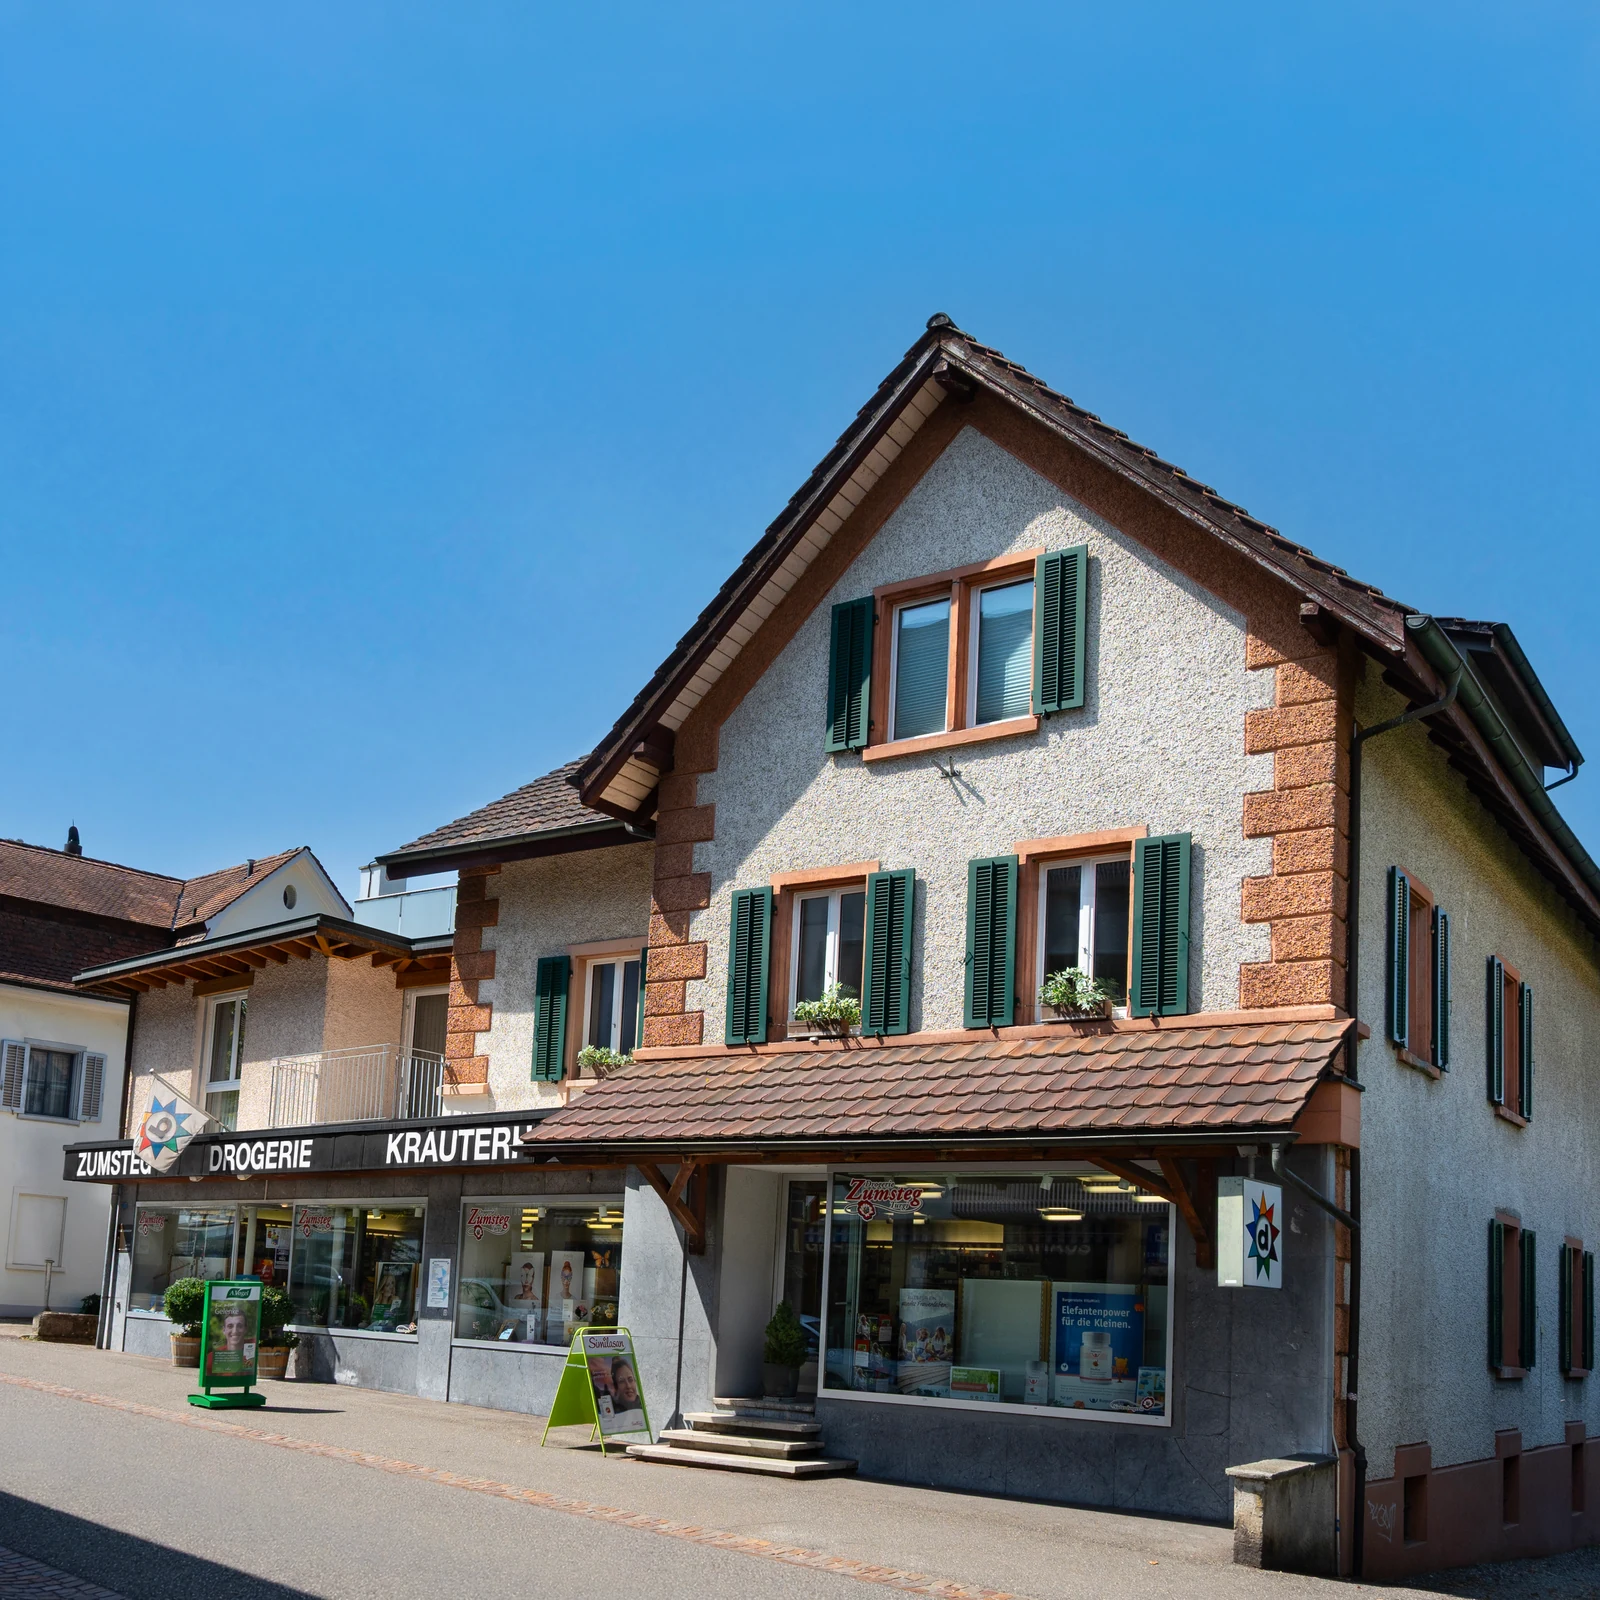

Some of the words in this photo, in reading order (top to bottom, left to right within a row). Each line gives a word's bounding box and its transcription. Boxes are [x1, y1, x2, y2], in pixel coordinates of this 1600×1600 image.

[209, 1139, 313, 1172] DROGERIE
[845, 1178, 922, 1207] Zumsteg
[865, 1180, 895, 1189] Drogerie
[139, 1210, 165, 1228] Zumsteg
[299, 1209, 332, 1228] Zumsteg
[467, 1208, 511, 1230] Zumsteg
[1258, 1224, 1268, 1251] d
[1061, 1305, 1130, 1318] Elefantenpower
[1061, 1317, 1074, 1326] für
[1077, 1317, 1091, 1327] die
[1094, 1319, 1131, 1329] Kleinen.
[588, 1336, 625, 1349] Similasan
